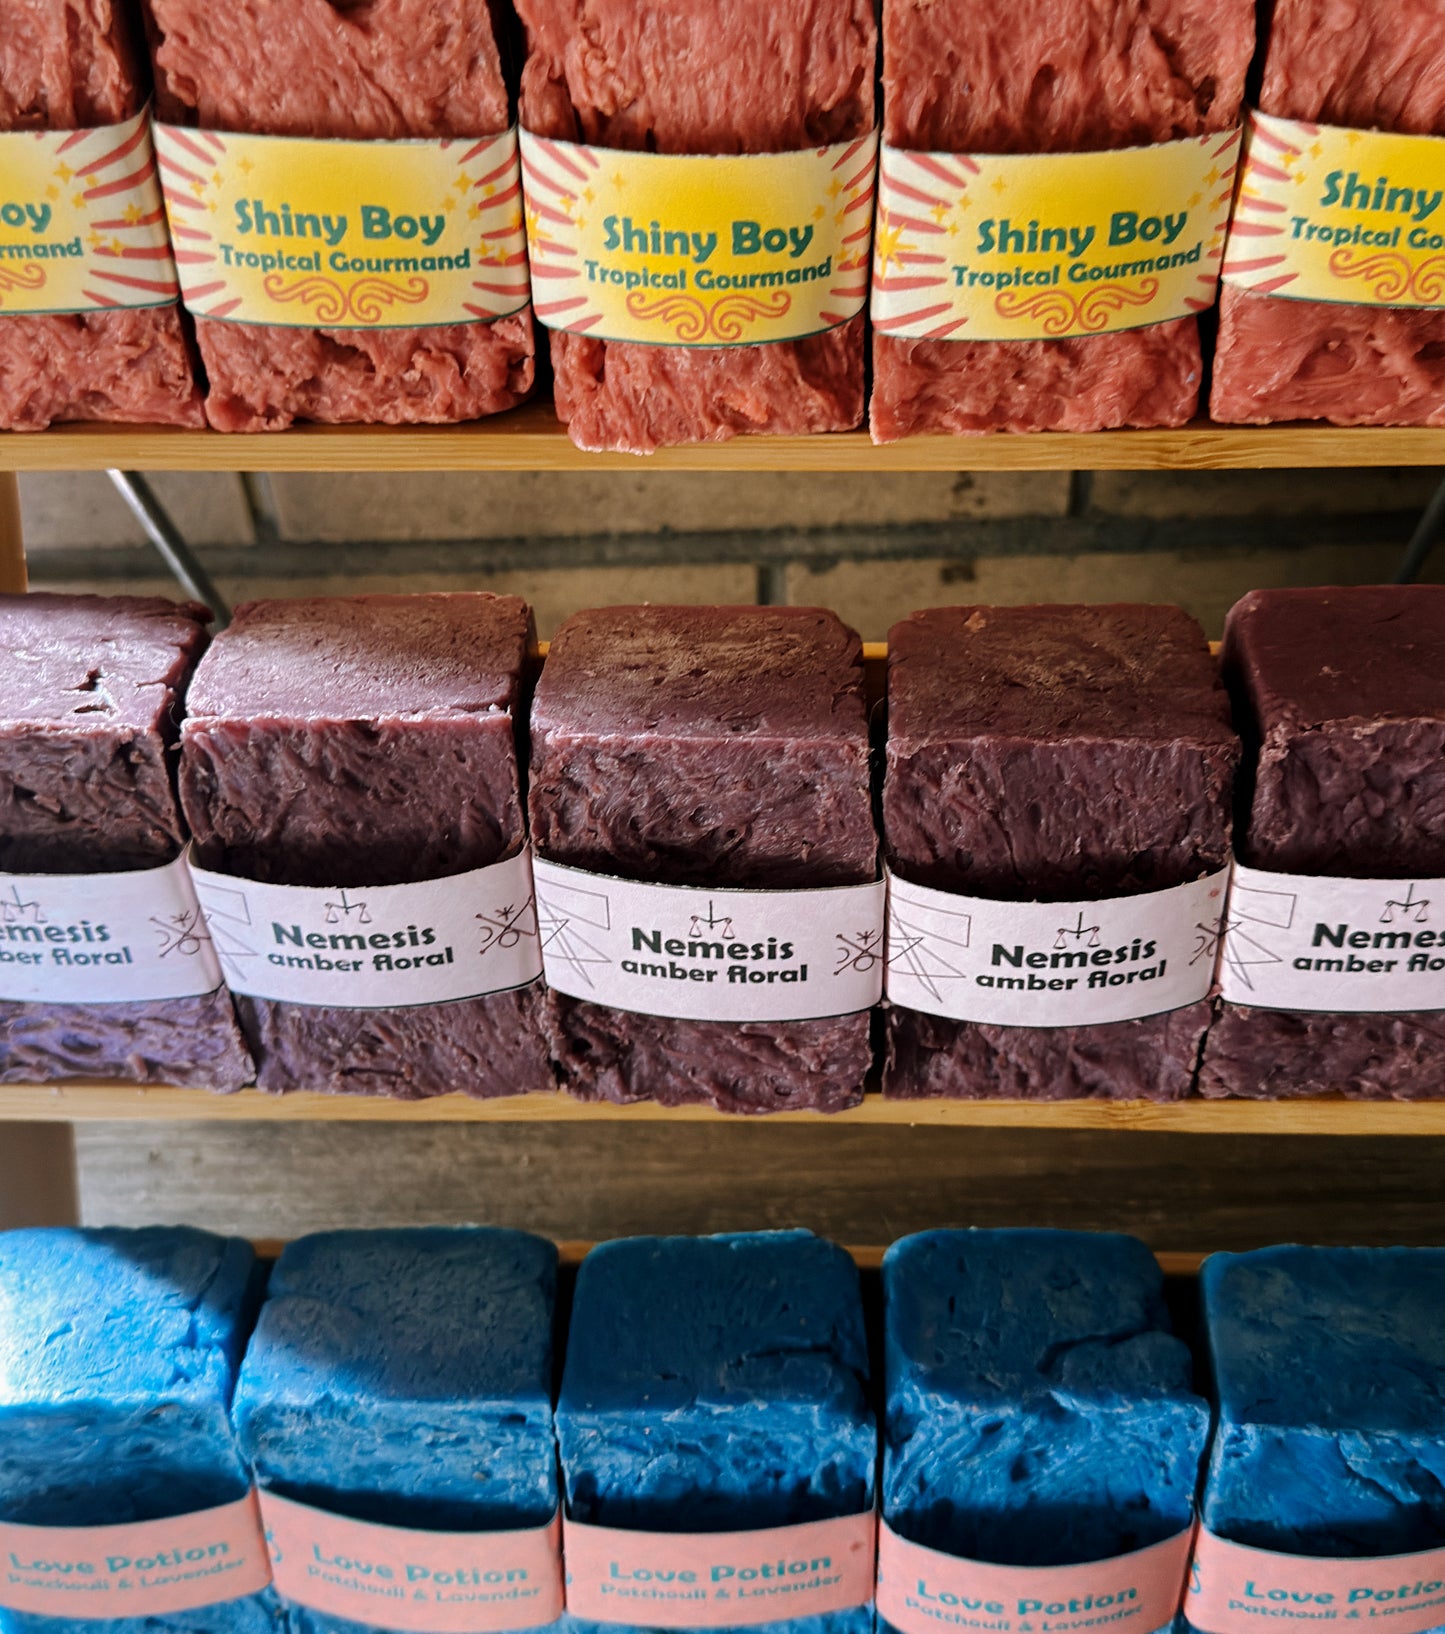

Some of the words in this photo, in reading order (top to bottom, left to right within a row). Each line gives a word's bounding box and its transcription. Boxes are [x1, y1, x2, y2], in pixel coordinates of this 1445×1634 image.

[1317, 168, 1445, 222] Shiny
[0, 202, 54, 234] oy
[233, 197, 349, 247] Shiny
[358, 204, 447, 246] Boy
[974, 216, 1096, 258] Shiny
[1107, 208, 1190, 248] Boy
[1288, 214, 1404, 249] Tropical
[1406, 226, 1445, 251] Go
[600, 214, 720, 264] Shiny
[731, 219, 815, 258] Boy
[218, 242, 322, 274] Tropical
[328, 247, 471, 273] Gourmand
[584, 259, 687, 290] Tropical
[693, 254, 833, 291] Gourmand
[950, 262, 1060, 293] Tropical
[1067, 240, 1204, 282] Gourmand
[271, 921, 438, 950] Nemesis
[629, 926, 796, 962] Nemesis
[988, 936, 1157, 970] Nemesis
[50, 944, 135, 967] floral
[265, 947, 365, 973] amber
[370, 945, 456, 973] floral
[618, 956, 720, 985] amber
[725, 962, 810, 985] floral
[1291, 952, 1400, 974] amber
[974, 968, 1079, 993] amber
[1086, 959, 1167, 992] floral
[8, 1550, 97, 1575] Love
[104, 1540, 231, 1574] Potion
[117, 1577, 136, 1590] &
[141, 1555, 246, 1588] Lavender
[310, 1541, 394, 1581] Love
[403, 1563, 530, 1587] Potion
[608, 1560, 698, 1584] Love
[709, 1555, 833, 1584] Potion
[306, 1562, 407, 1599] Patchouli
[412, 1588, 429, 1602] &
[434, 1585, 544, 1604] Lavender
[601, 1581, 708, 1602] Patchouli
[714, 1588, 730, 1601] &
[737, 1572, 843, 1600] Lavender
[915, 1578, 1006, 1615] Love
[1016, 1585, 1138, 1617] Potion
[1243, 1578, 1337, 1606] Love
[905, 1596, 1010, 1633] Patchouli
[1019, 1620, 1034, 1633] &
[1042, 1602, 1143, 1632] Lavender
[1227, 1599, 1338, 1621] Patchouli
[1344, 1607, 1361, 1621] &
